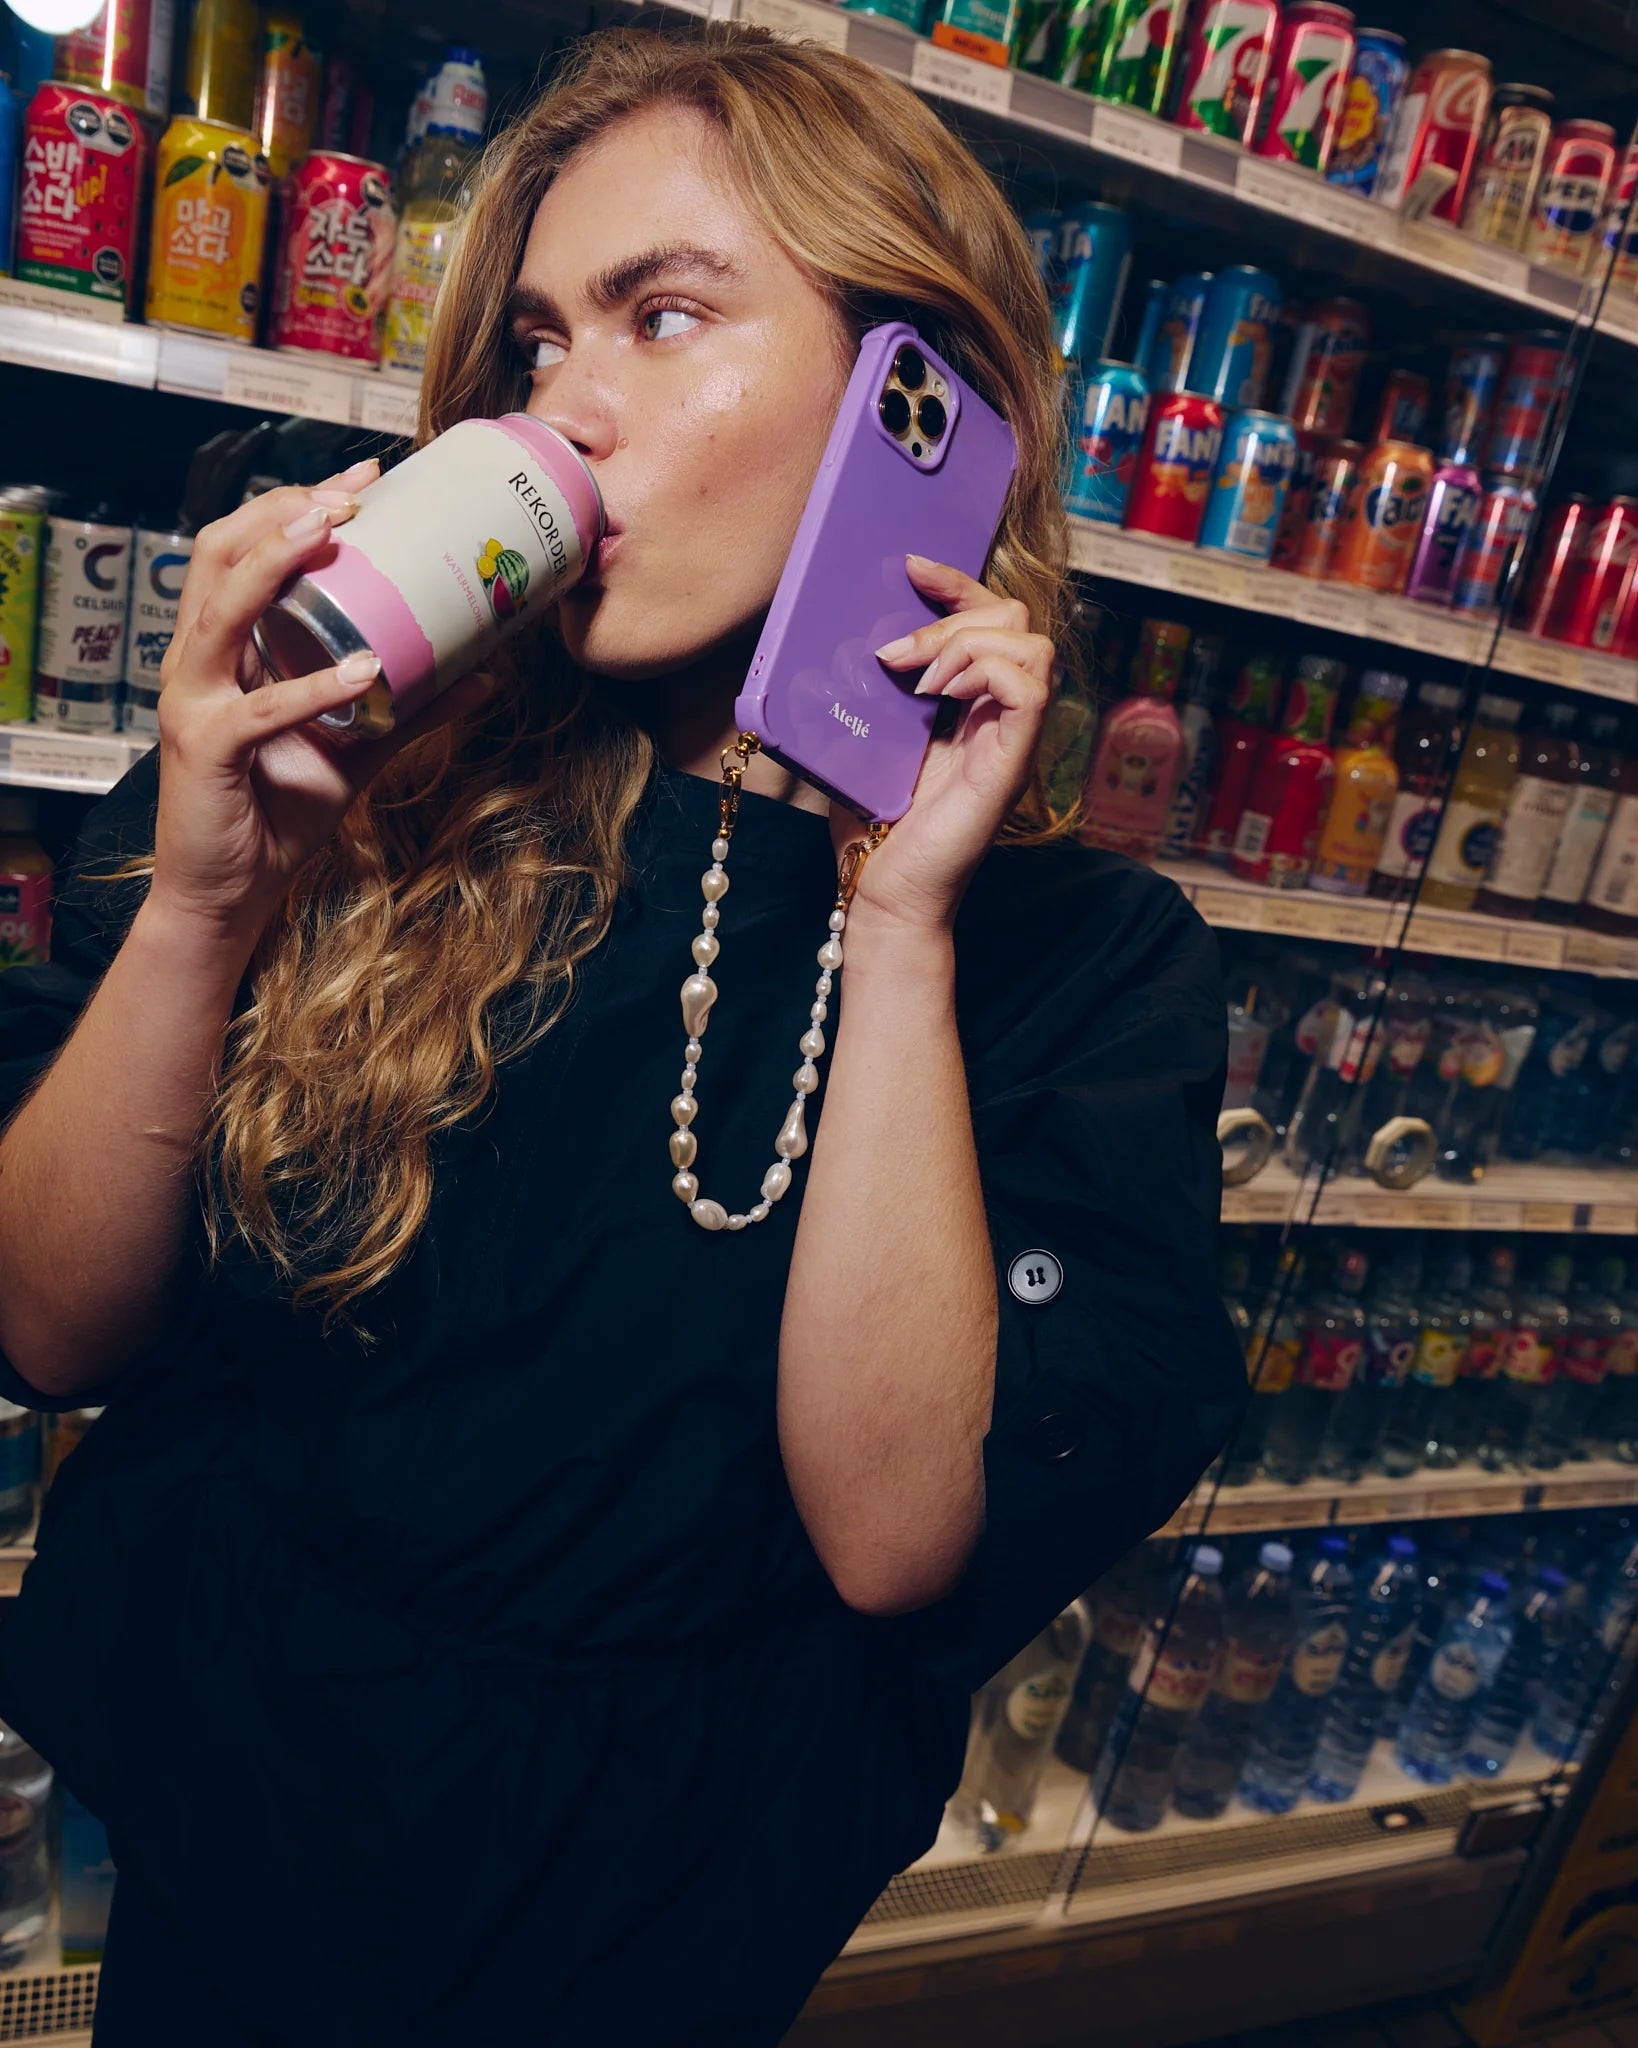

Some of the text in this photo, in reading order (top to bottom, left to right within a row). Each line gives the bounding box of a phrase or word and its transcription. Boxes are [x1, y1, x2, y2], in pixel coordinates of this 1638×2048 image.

[24, 135, 82, 188] 수박
[22, 163, 108, 222] 소다 UP!
[175, 196, 232, 237] 망고
[308, 206, 373, 255] 자두
[169, 227, 229, 265] 소다
[303, 242, 369, 288] 소다
[828, 702, 871, 738] Ateljé
